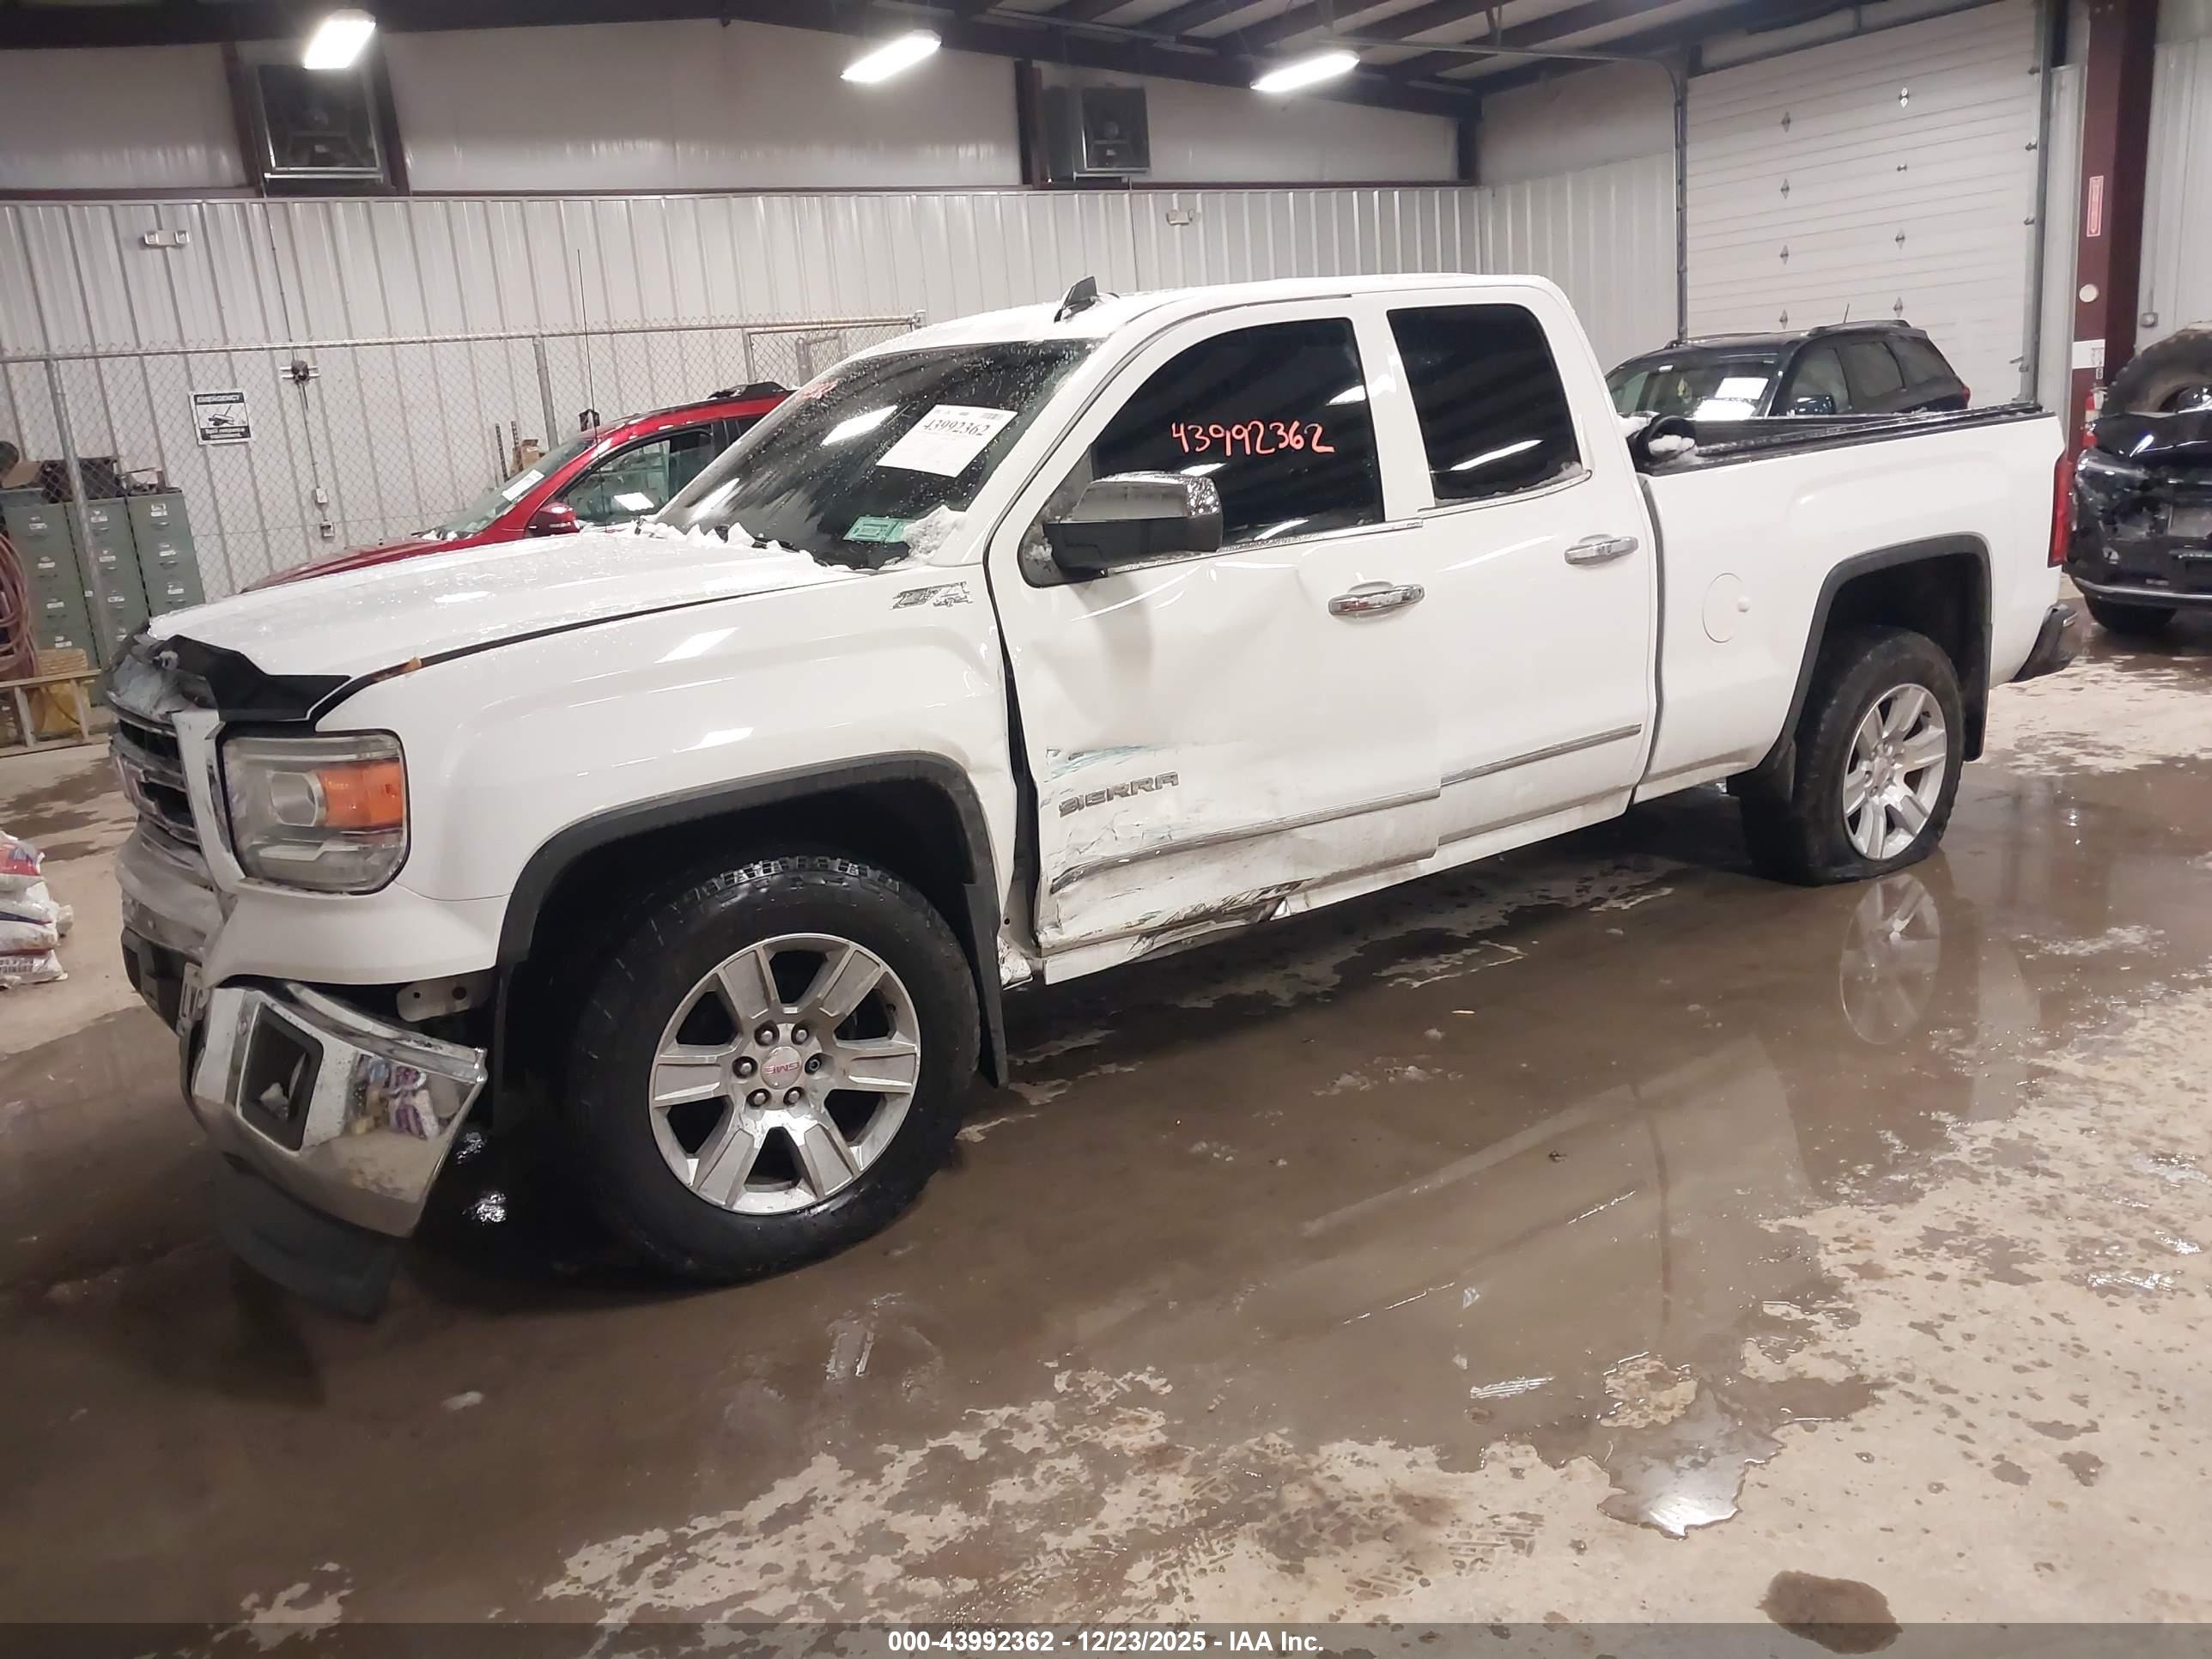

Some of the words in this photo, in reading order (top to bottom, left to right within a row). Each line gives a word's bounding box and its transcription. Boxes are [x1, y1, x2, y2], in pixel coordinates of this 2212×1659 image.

[924, 419, 991, 436] 43992362
[1171, 420, 1336, 457] 43992362
[1058, 771, 1180, 818] SIERRA
